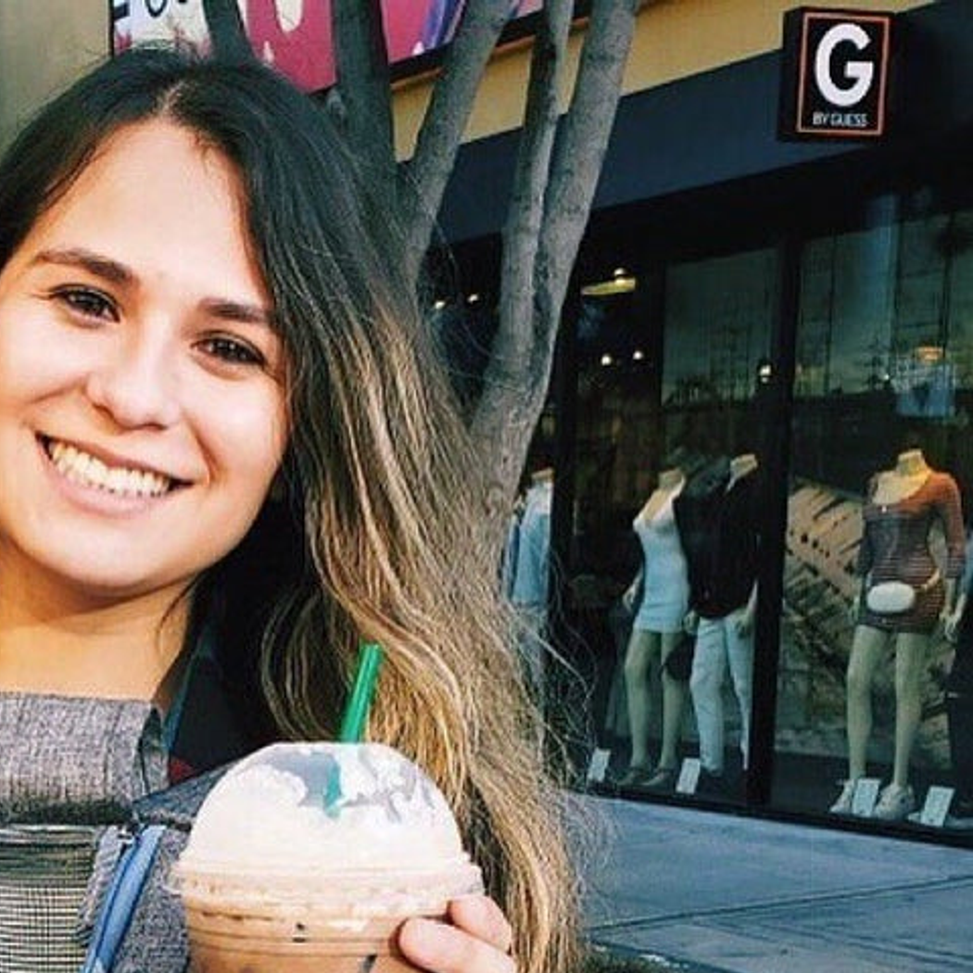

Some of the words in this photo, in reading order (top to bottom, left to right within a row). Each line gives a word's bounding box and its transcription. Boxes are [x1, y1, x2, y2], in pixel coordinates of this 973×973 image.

[815, 23, 874, 107] G
[812, 111, 829, 125] BY
[830, 112, 868, 127] GUESS
